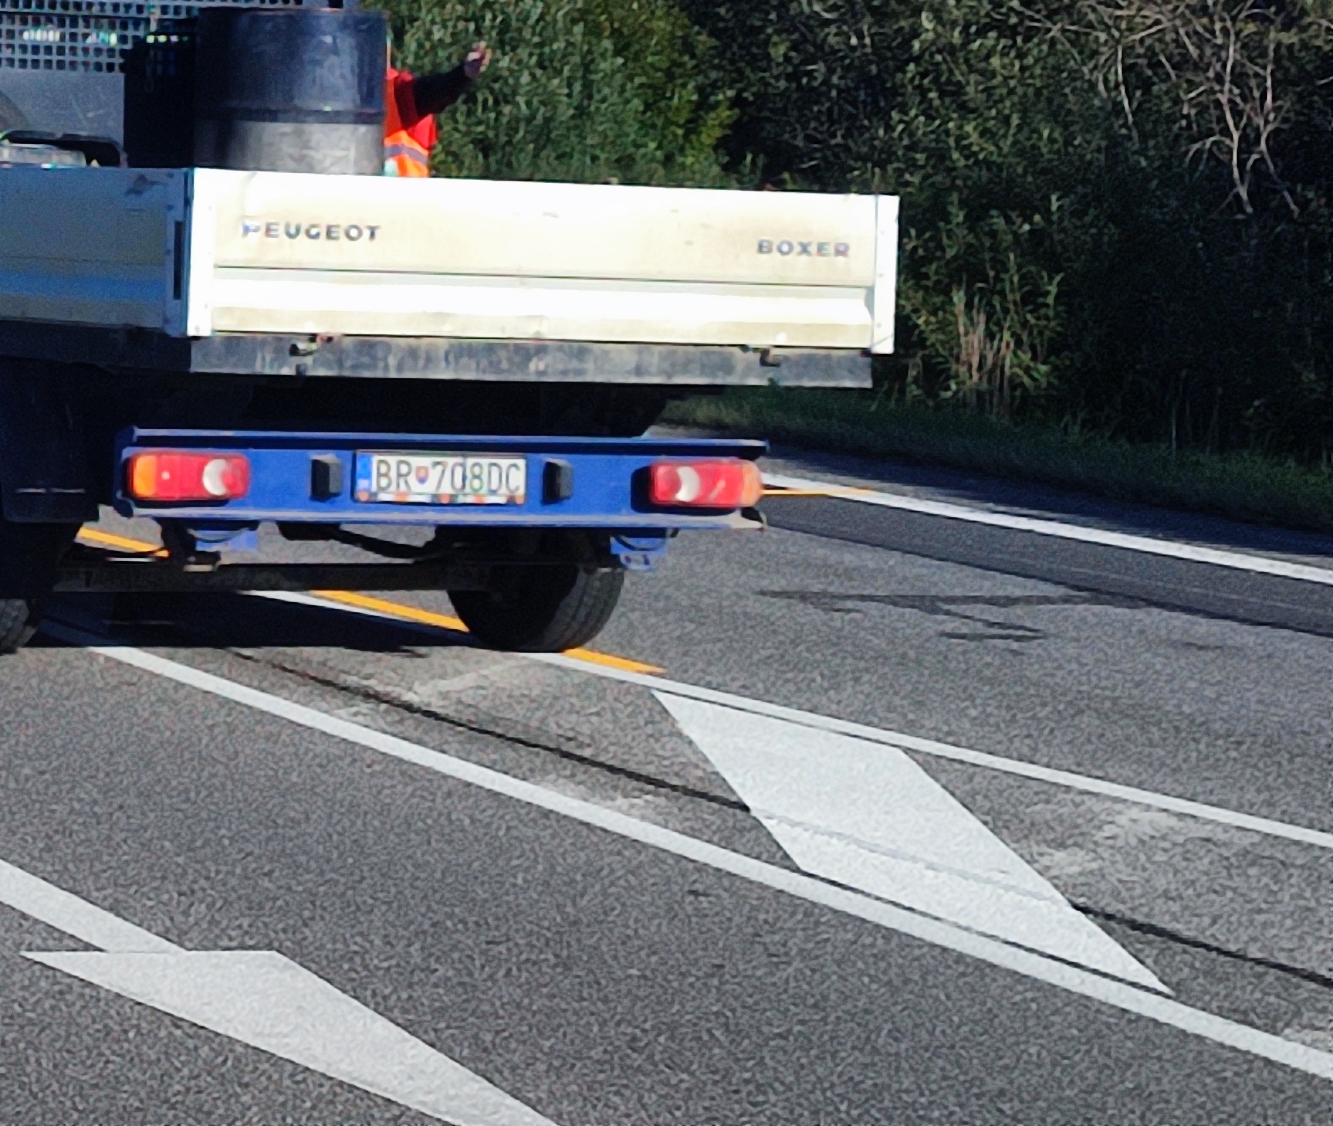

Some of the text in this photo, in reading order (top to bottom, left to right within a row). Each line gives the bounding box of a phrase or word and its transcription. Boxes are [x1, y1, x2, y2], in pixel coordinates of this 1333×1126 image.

[242, 221, 381, 242] PEUGEOT
[756, 239, 850, 258] BOXER
[376, 459, 412, 493] BR
